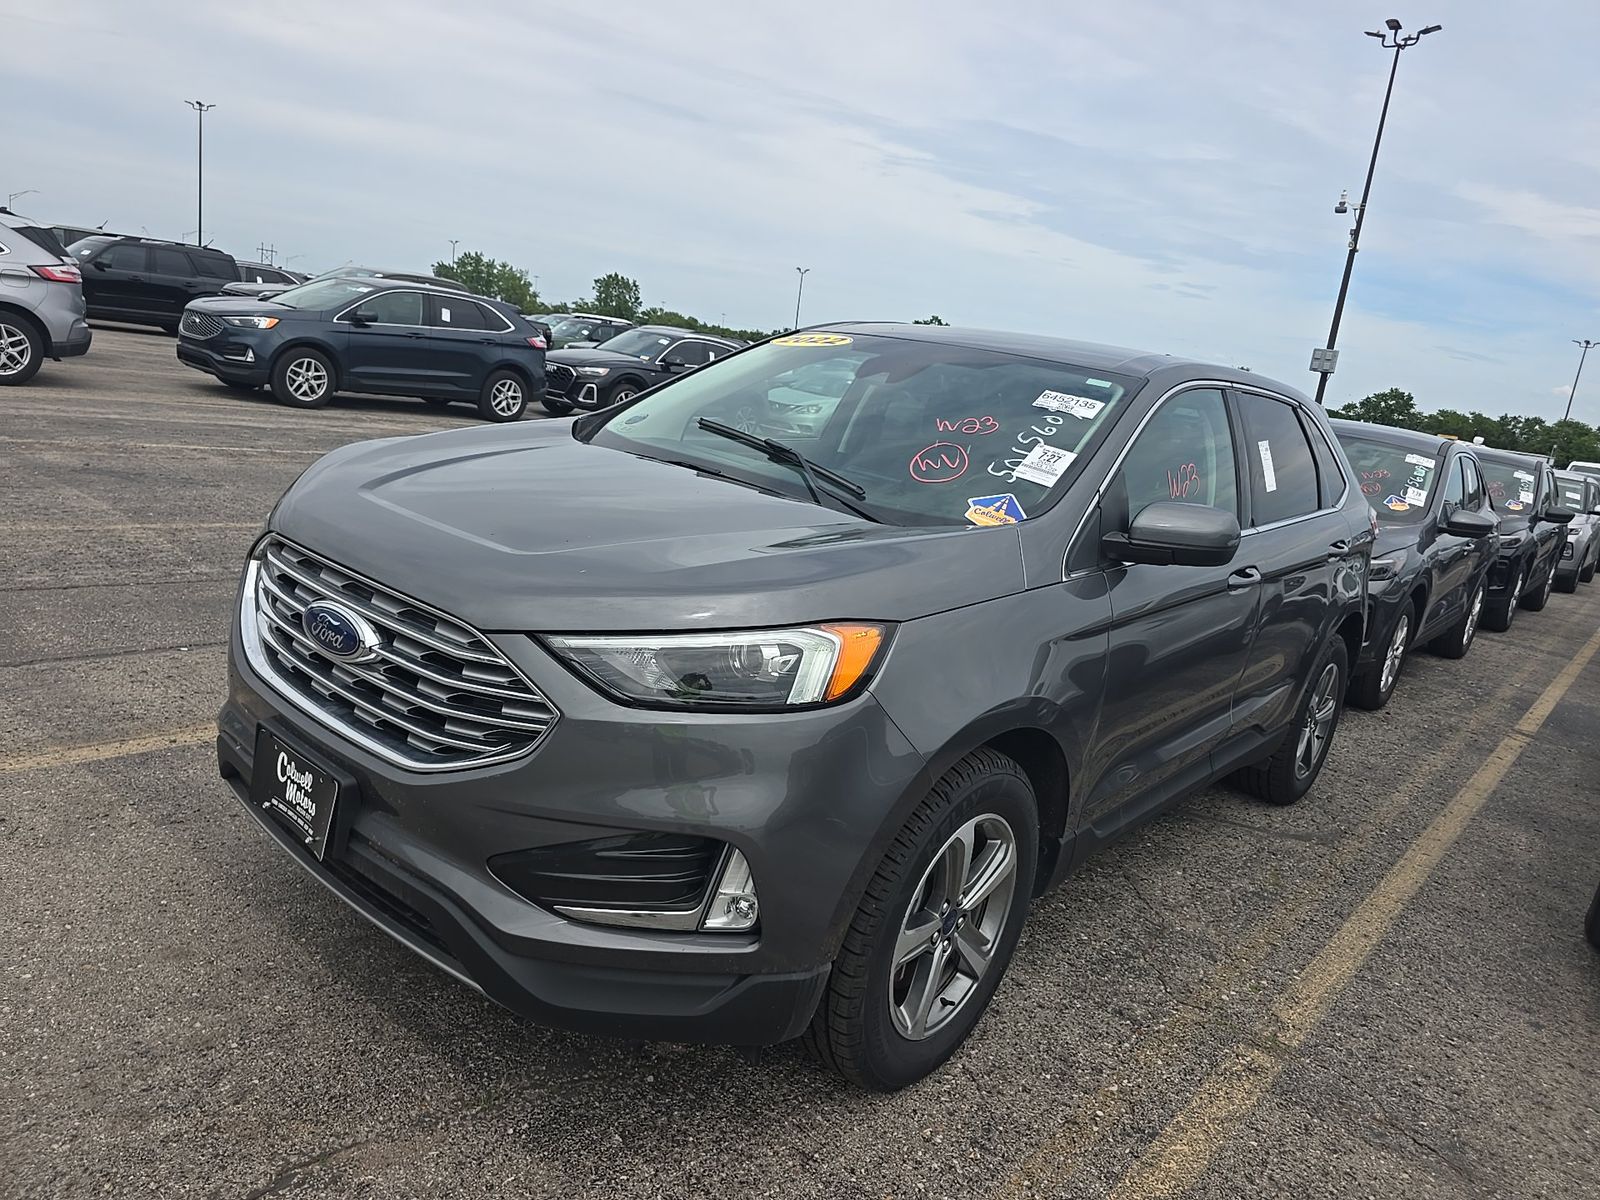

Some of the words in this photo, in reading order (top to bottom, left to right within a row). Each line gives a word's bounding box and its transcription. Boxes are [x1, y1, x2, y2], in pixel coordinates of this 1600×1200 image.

[1041, 393, 1097, 410] 6452135
[1038, 451, 1063, 464] 7:27
[311, 613, 346, 648] Ford
[277, 751, 314, 793] Colwell
[285, 779, 317, 818] Motors
